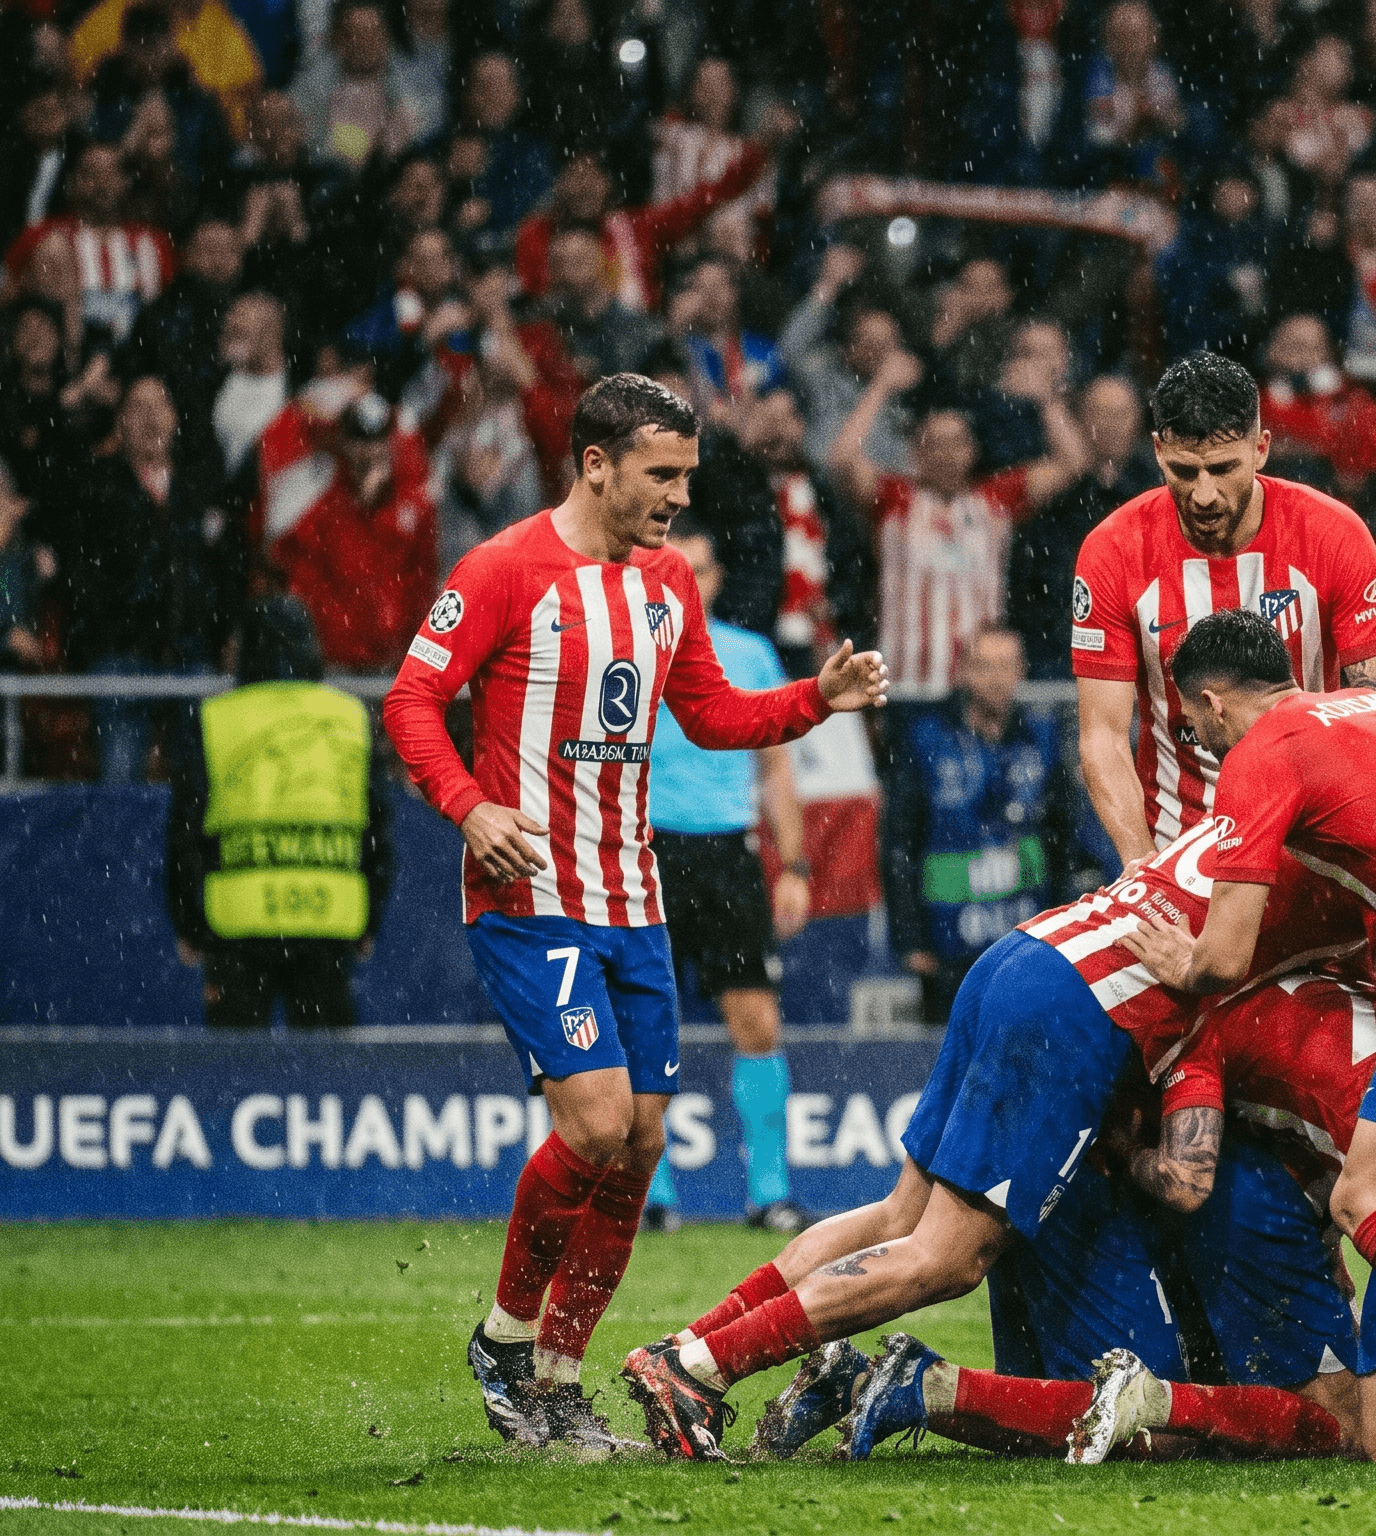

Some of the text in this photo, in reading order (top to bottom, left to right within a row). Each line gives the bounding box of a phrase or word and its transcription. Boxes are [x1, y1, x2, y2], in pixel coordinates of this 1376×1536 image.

[546, 946, 580, 1007] 7
[0, 1093, 213, 1170] UEFA
[231, 1093, 717, 1170] CHAMPIS
